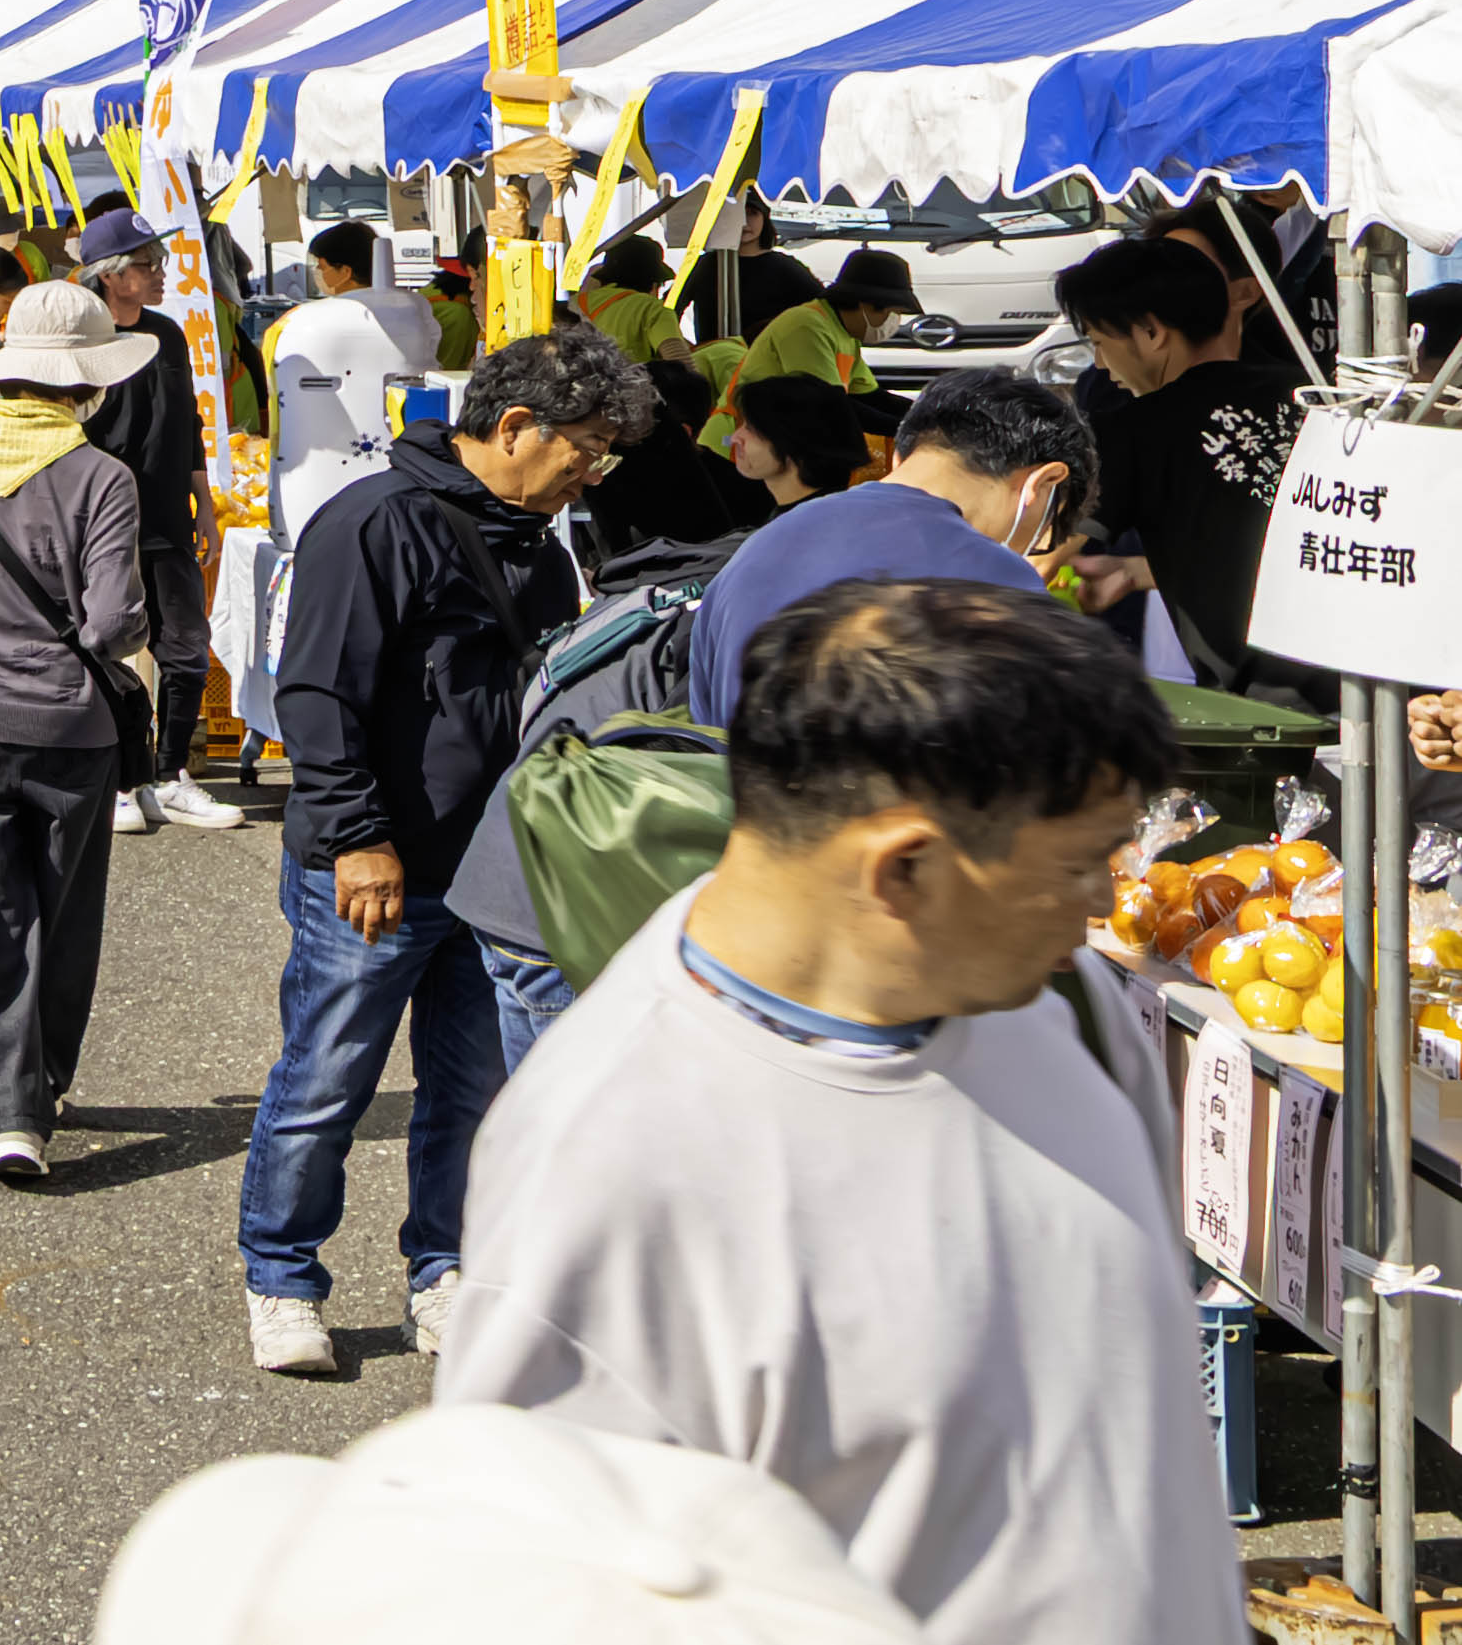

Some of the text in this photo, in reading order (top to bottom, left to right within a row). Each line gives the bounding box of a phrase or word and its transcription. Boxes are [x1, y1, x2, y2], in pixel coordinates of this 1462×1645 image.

[1292, 472, 1389, 523] JAしみず
[1299, 531, 1416, 587] 青壮年部
